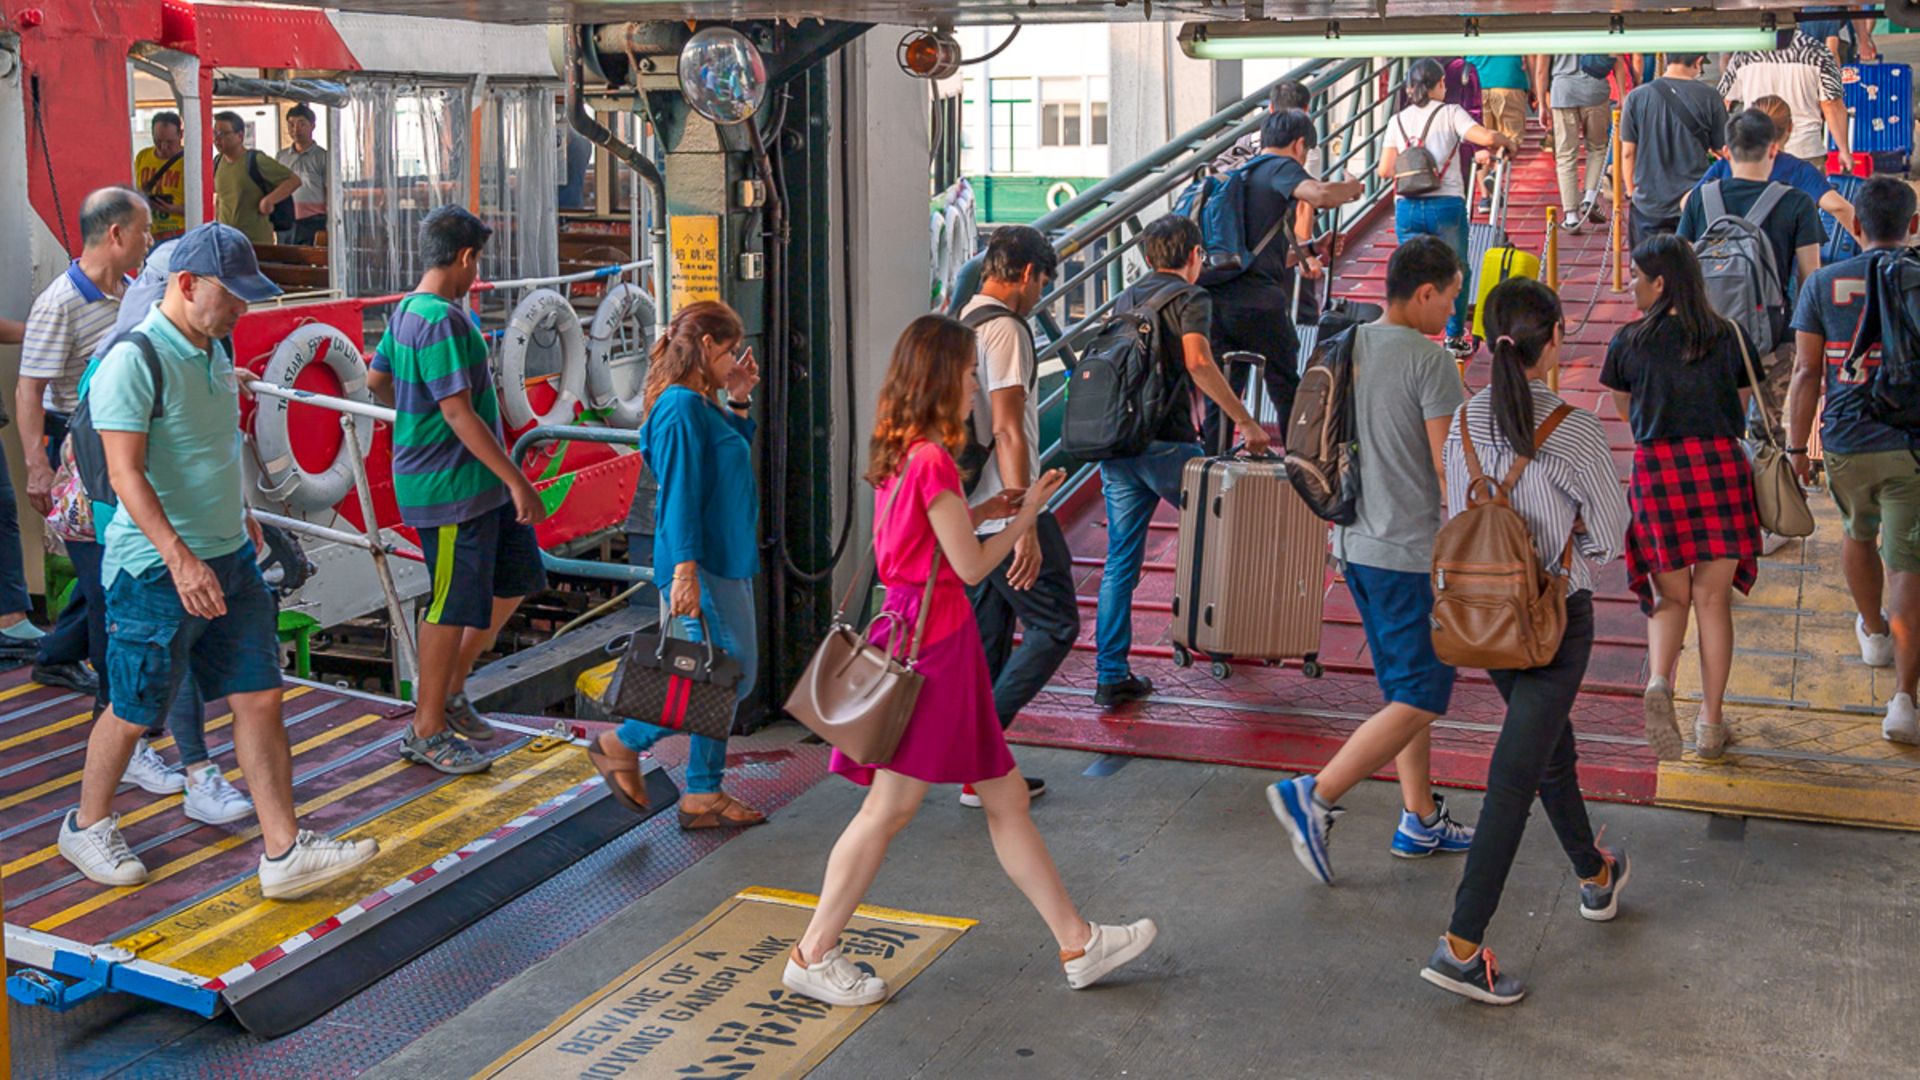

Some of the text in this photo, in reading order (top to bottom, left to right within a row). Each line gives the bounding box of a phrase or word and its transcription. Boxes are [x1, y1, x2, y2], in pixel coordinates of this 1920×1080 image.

[682, 232, 708, 245] 小心
[284, 352, 304, 382] STAR
[556, 950, 727, 1054] BEWARE OF A
[660, 935, 797, 1022] GANGPLANK
